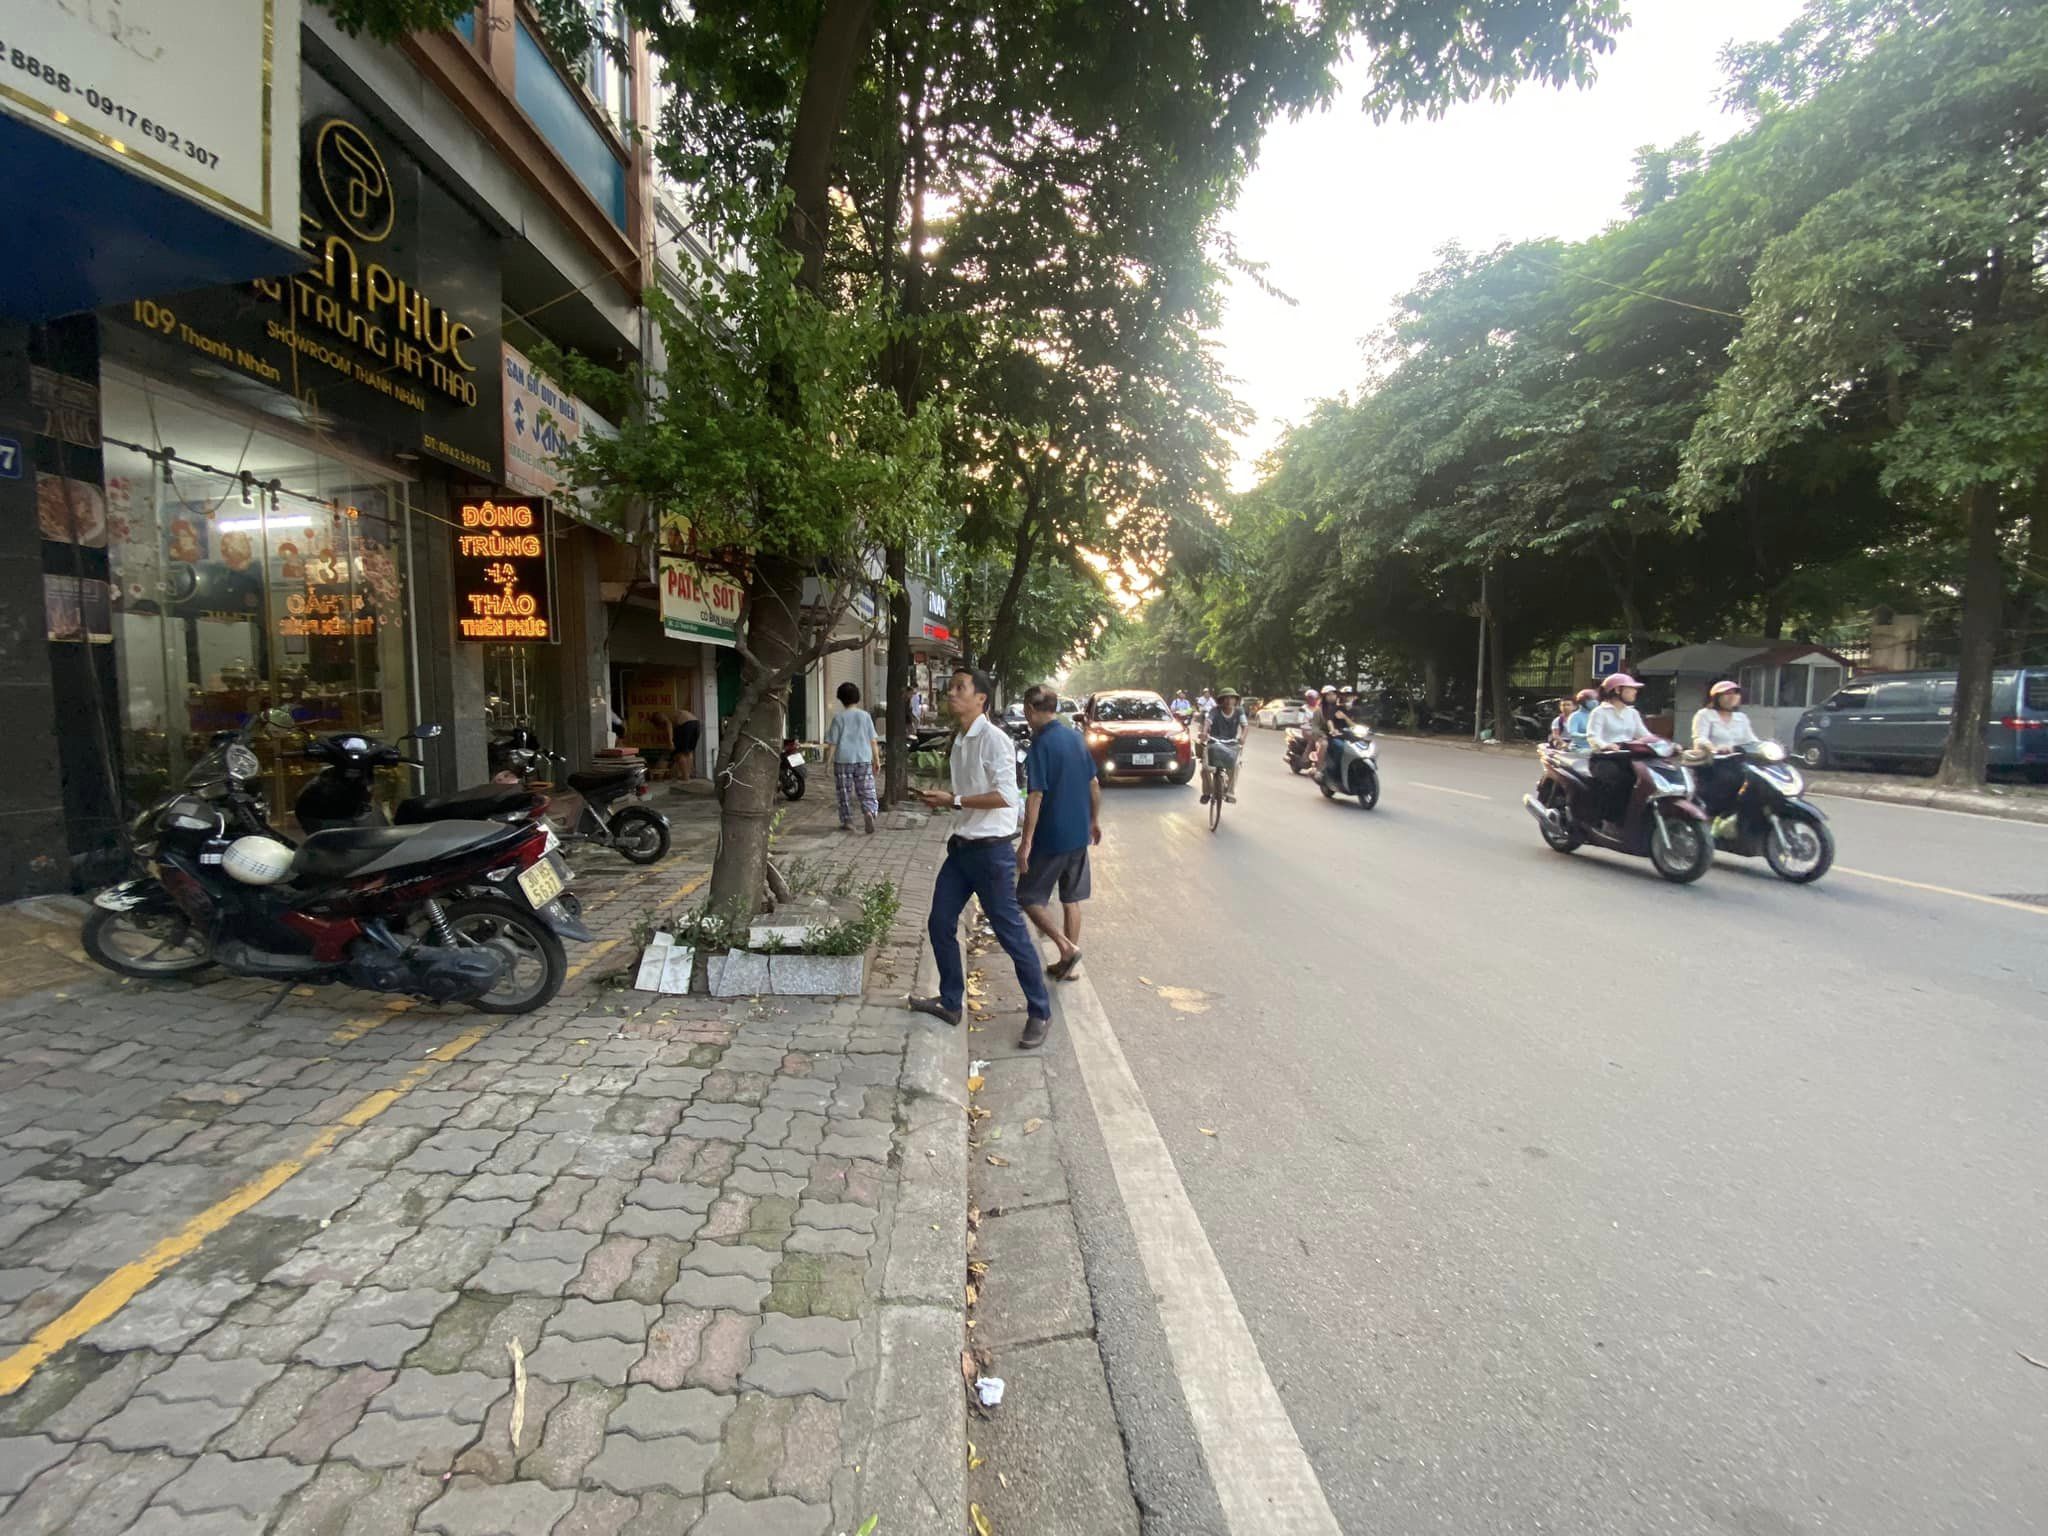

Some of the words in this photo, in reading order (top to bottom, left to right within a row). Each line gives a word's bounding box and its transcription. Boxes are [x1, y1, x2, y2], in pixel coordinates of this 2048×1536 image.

[134, 299, 176, 334] 109
[462, 501, 532, 528] ĐÔNG
[458, 530, 541, 557] TRÙNG
[506, 616, 549, 637] PHÚC
[1599, 651, 1615, 673] P
